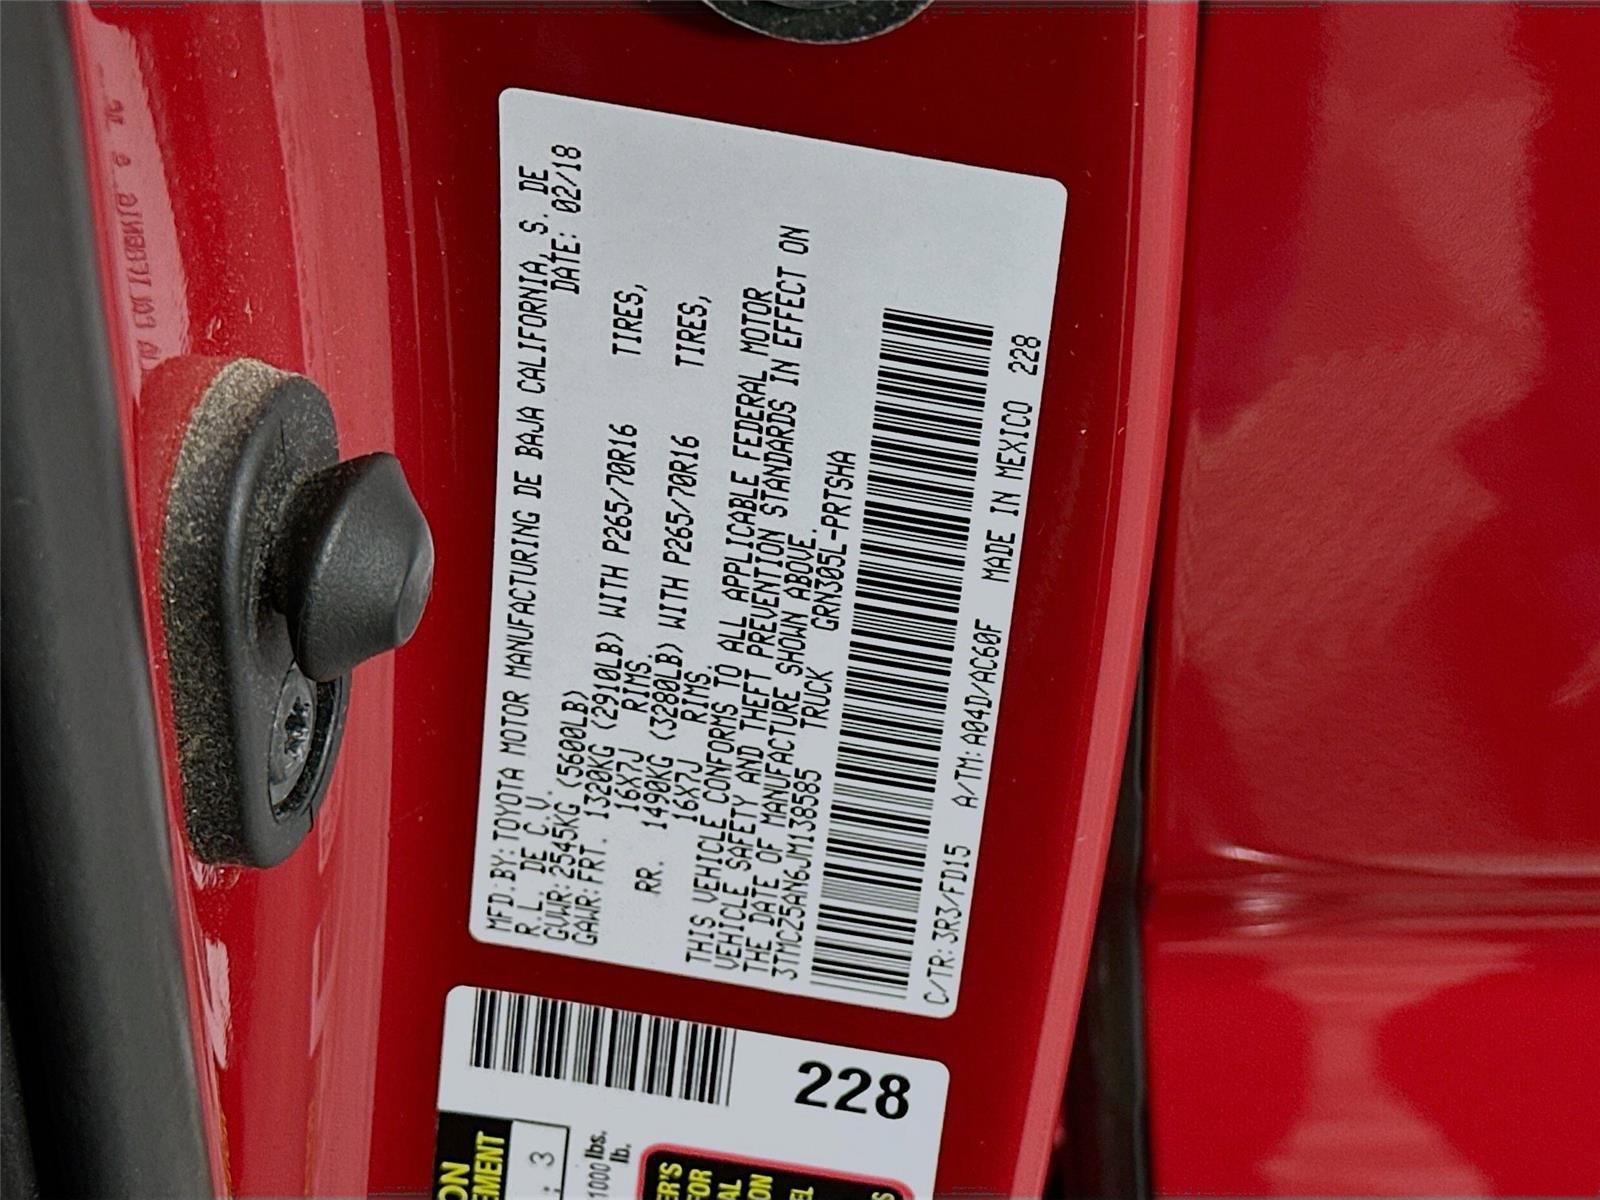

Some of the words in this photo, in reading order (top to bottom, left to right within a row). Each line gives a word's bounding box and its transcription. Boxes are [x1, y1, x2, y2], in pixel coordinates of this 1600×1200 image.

[519, 165, 549, 196] DE
[551, 144, 583, 214] 02/18
[519, 214, 549, 235] S.
[778, 225, 810, 255] ON
[550, 232, 581, 295] DATE:
[516, 252, 553, 394] CALIFORNIA,
[612, 284, 648, 355] TIRES,
[675, 296, 711, 367] TIRES,
[739, 287, 774, 357] MOTOR
[772, 264, 807, 352] EFFECT
[770, 355, 800, 386] IN
[1008, 335, 1041, 376] 228
[514, 406, 544, 460] BAJA
[732, 370, 768, 461] FEDERAL
[994, 400, 1033, 480] MEXICO
[513, 470, 542, 499] DE
[602, 423, 637, 557] P265/70R16
[759, 396, 797, 520] STANDARDS
[662, 435, 699, 566] P265/70R16
[989, 491, 1021, 517] IN
[721, 470, 761, 603] APPLICABLE
[783, 529, 817, 601] ABOVE.
[810, 450, 859, 632] GRN305L-PRTSHA
[981, 529, 1016, 583] MADE
[504, 510, 540, 680] MANUFACTURING
[598, 564, 629, 619] WITH
[657, 575, 689, 630] WITH
[746, 527, 786, 659] PREVENTION
[717, 616, 748, 654] ALL
[775, 610, 809, 677] SHOWN
[590, 632, 624, 730] (2910LB)
[621, 654, 653, 714] RIMS.
[648, 643, 684, 741] (3280LB)
[680, 666, 712, 725] RIMS.
[713, 664, 742, 688] TO
[739, 668, 773, 731] THEFT
[800, 666, 834, 729] TRUCK
[498, 690, 530, 756] MOTOR
[556, 690, 590, 788] (5600LB)
[703, 701, 739, 804] CONFORMS
[583, 743, 616, 820] 1320KG
[614, 747, 644, 813] 16X7J
[734, 745, 764, 785] AND
[760, 686, 801, 828] MANUFACTURE
[641, 754, 674, 830] 1490KG
[672, 758, 703, 823] 16X7J
[520, 846, 547, 875] DE
[694, 815, 727, 903] VEHICLE
[726, 794, 759, 872] SAFETY
[756, 837, 783, 864] OF
[635, 862, 664, 897] RR.
[749, 874, 780, 927] DATE
[774, 767, 822, 981] 3TMCZ5AN6JM138585
[689, 914, 716, 963] THIS
[716, 882, 749, 970] VEHICLE
[745, 936, 772, 972] THE
[795, 1060, 911, 1120] 228
[529, 1150, 555, 1167] 3
[584, 1130, 608, 1159] lbs.
[609, 1143, 631, 1163] lb.
